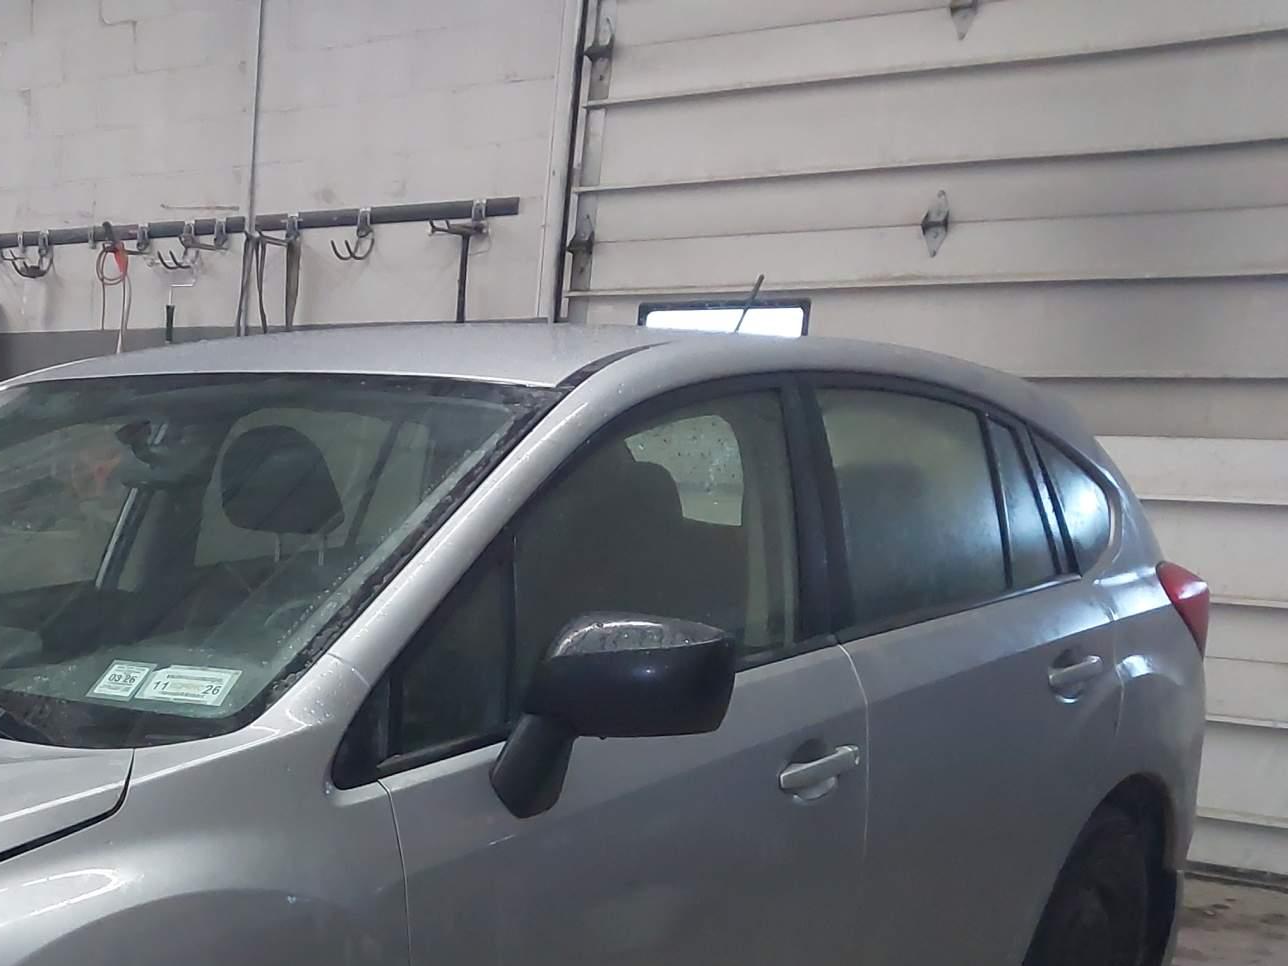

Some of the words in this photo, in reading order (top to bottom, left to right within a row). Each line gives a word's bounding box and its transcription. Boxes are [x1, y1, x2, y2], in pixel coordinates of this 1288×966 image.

[108, 673, 122, 682] 03
[123, 674, 138, 684] 26
[153, 680, 169, 690] 11
[201, 684, 222, 696] 26
